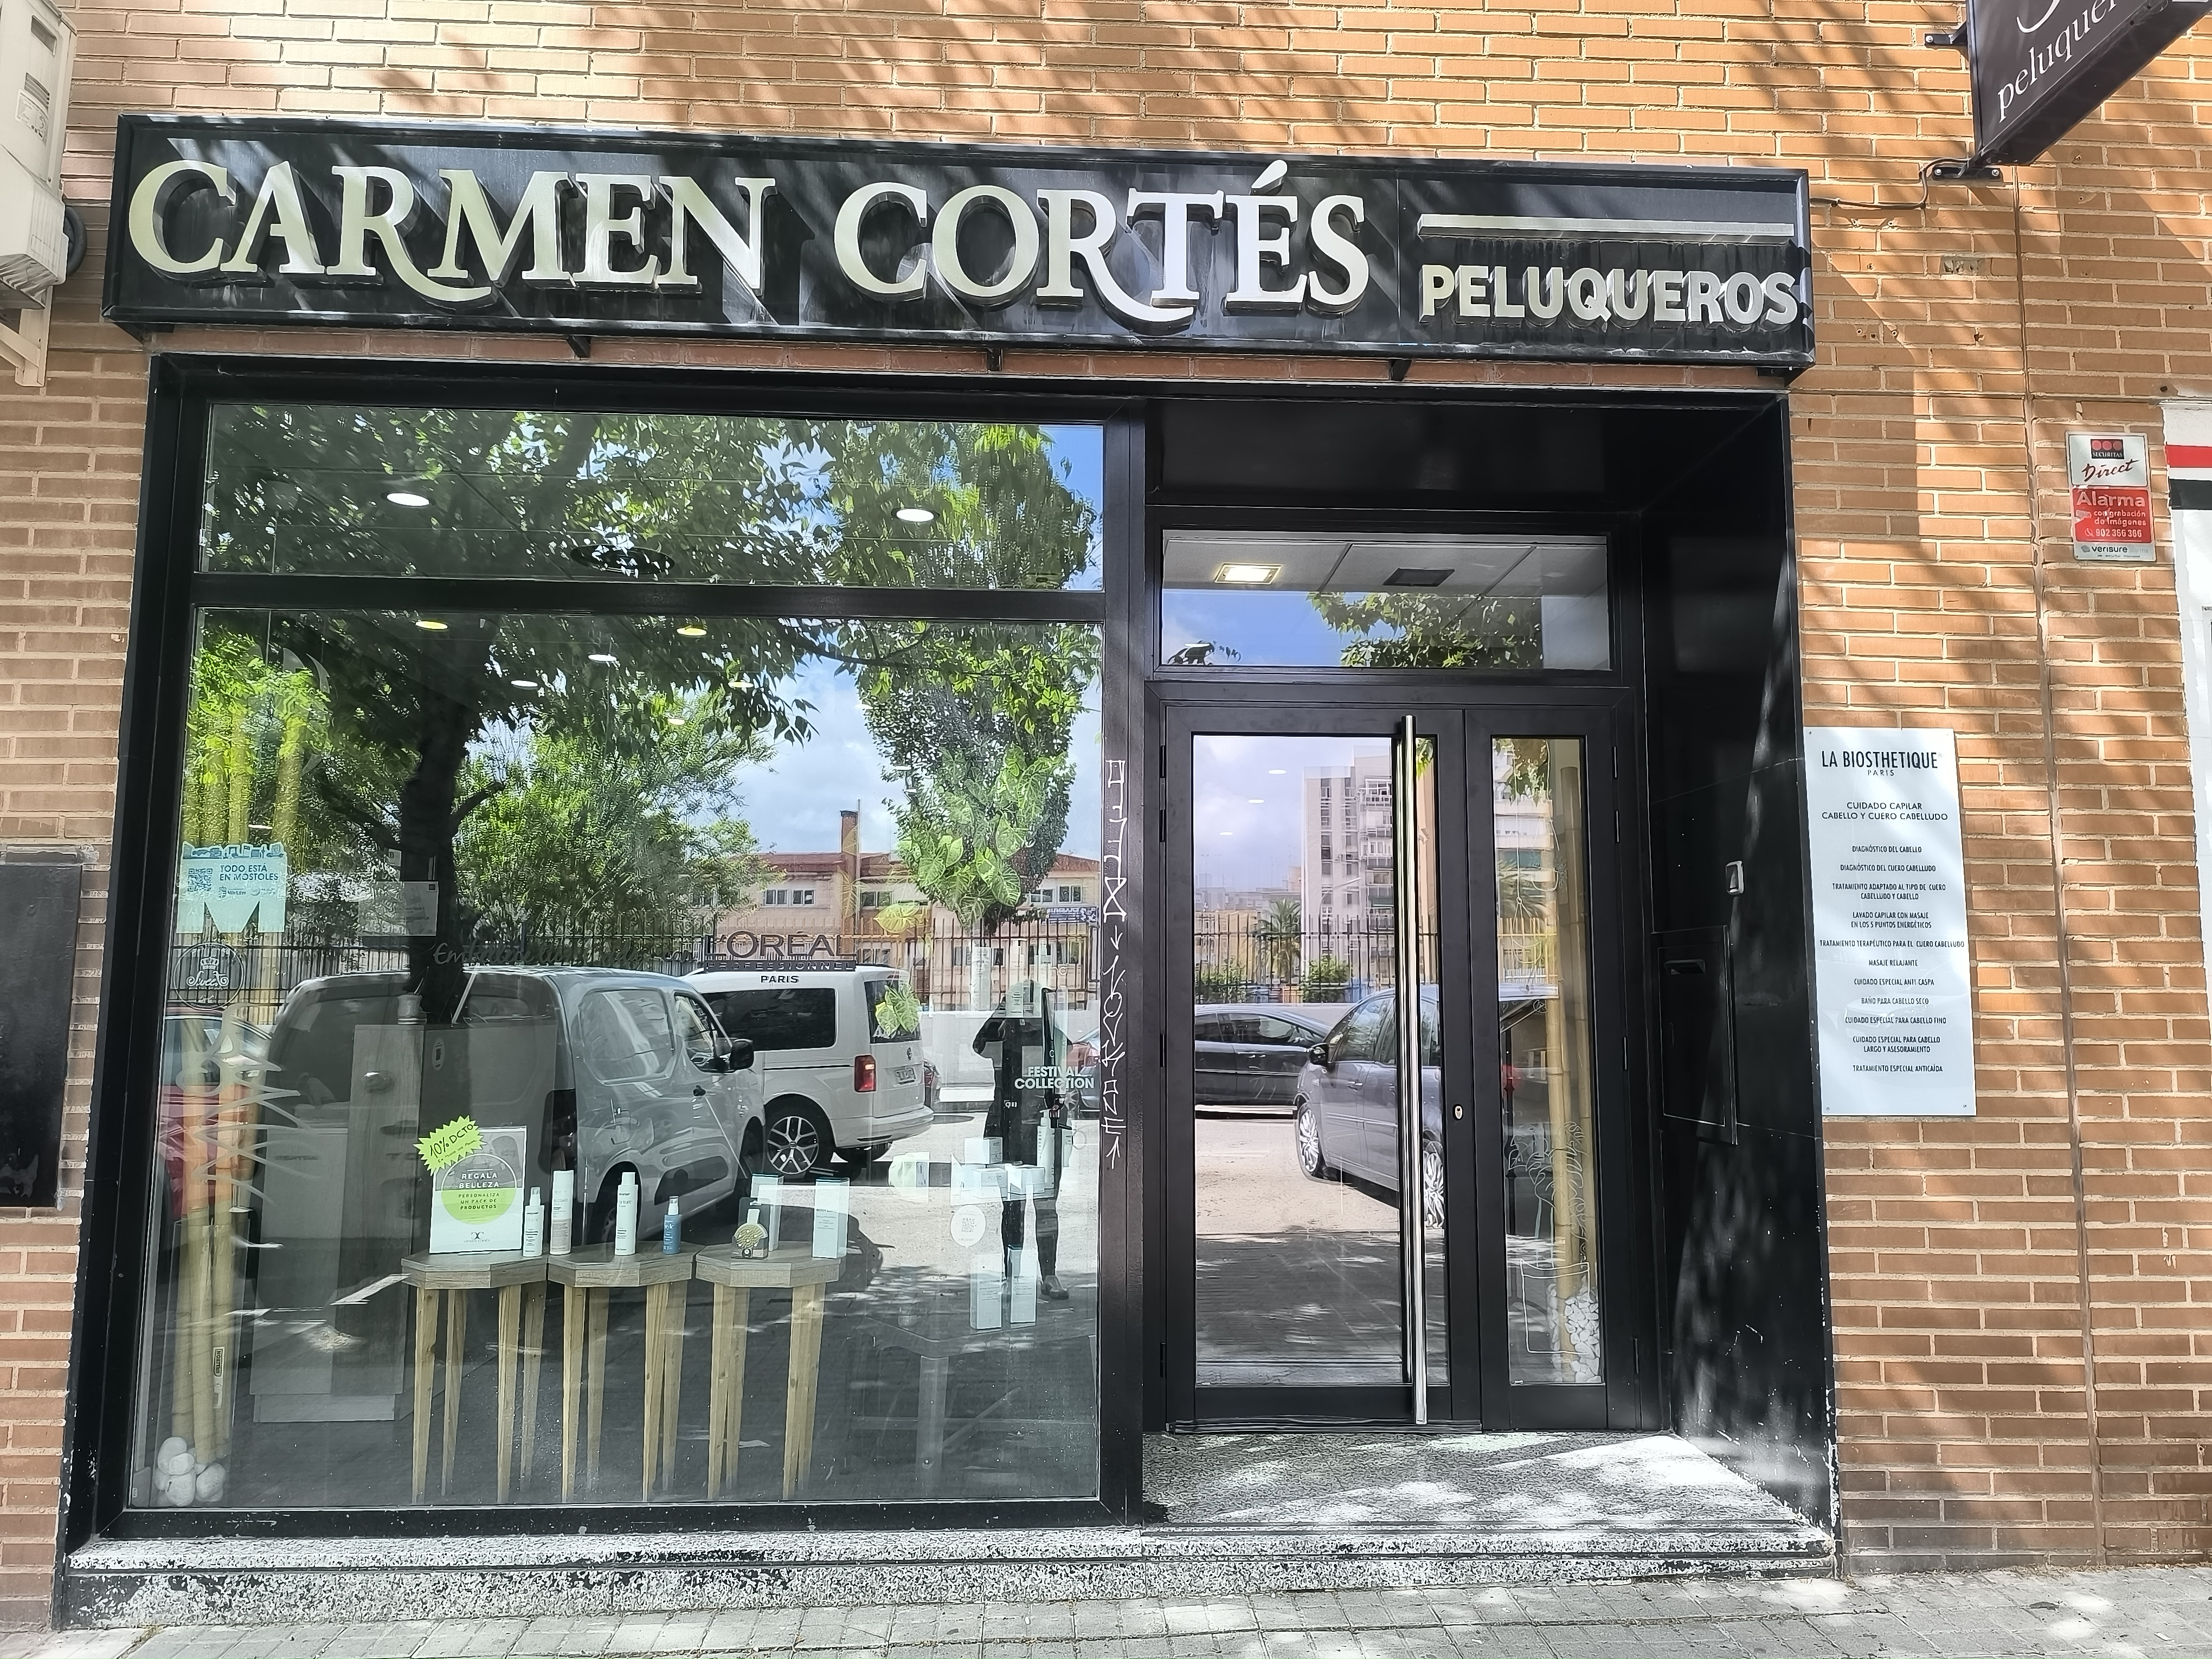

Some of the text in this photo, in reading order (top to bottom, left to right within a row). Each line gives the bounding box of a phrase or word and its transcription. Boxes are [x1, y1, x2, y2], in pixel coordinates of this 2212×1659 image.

[129, 159, 1369, 323] CARMEN CORTÉS
[1419, 264, 1799, 329] PELUQUEROS
[2081, 459, 2140, 482] Direct
[2076, 491, 2145, 507] Alarma
[2111, 510, 2146, 519] grabación
[2095, 529, 2110, 537] 902
[2092, 545, 2128, 553] verisure
[1822, 750, 1938, 769] LA BIOSTHETIQUE
[1852, 844, 1887, 853] DIAGNÓSTICO
[248, 862, 267, 872] ESTÁ
[1841, 863, 1875, 871] DIAGNÓSTICO
[1898, 920, 1932, 928] ENERGÉTICOS
[705, 930, 857, 959] L'ORÉAL
[706, 962, 853, 970] PROFESSIONNEL
[1861, 996, 1876, 1004] BAÑO
[1028, 1066, 1081, 1077] FESTIVAL
[1915, 1064, 1943, 1072] ANTICAÍDA
[1014, 1078, 1094, 1089] COLLECTION
[430, 1124, 473, 1159] 10% DCTO
